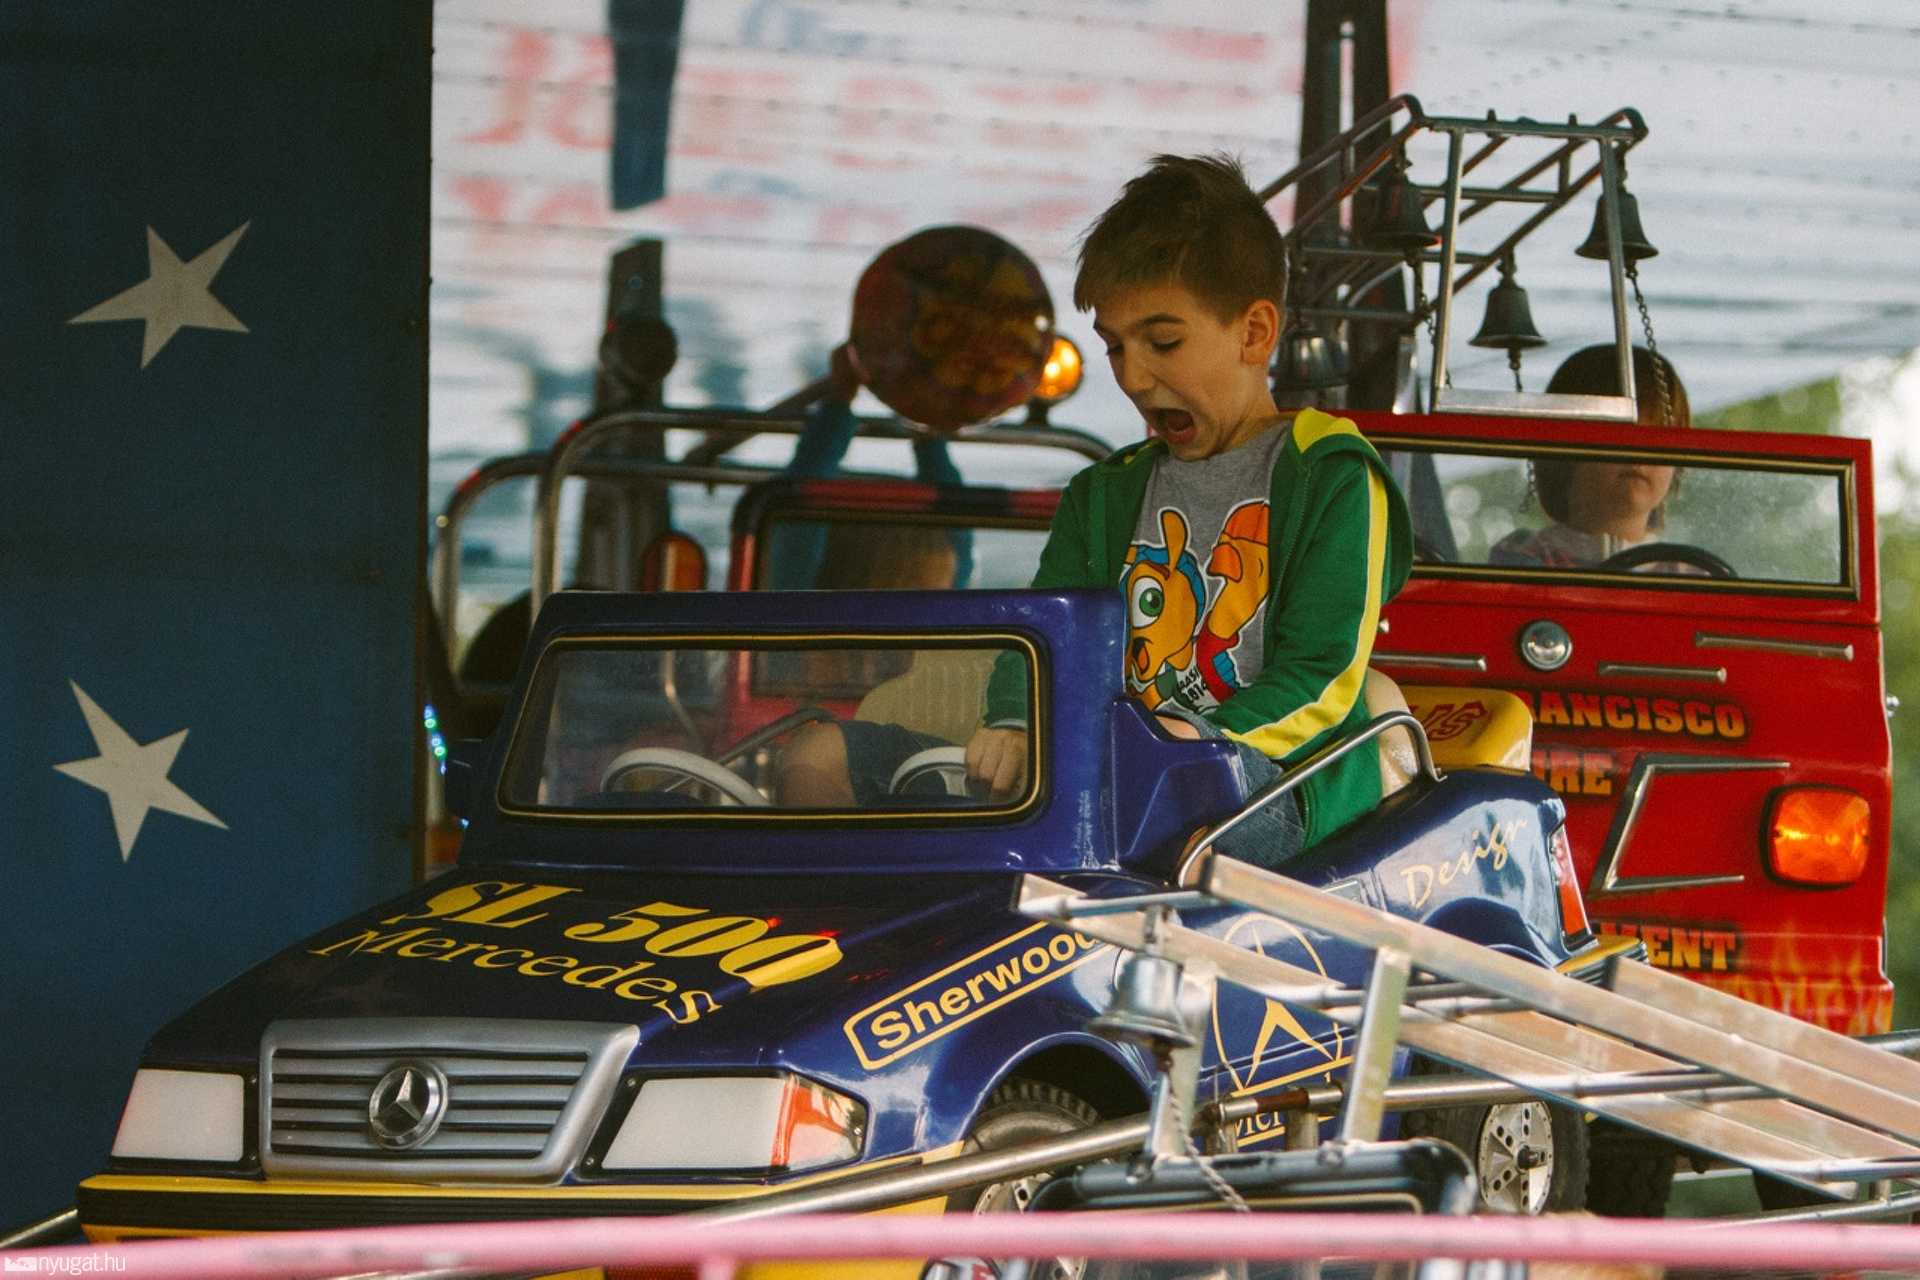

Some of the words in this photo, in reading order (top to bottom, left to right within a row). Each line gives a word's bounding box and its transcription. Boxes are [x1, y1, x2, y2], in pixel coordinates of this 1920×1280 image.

[308, 927, 723, 1024] Mercedes
[381, 880, 585, 929] SL
[563, 902, 844, 988] 500
